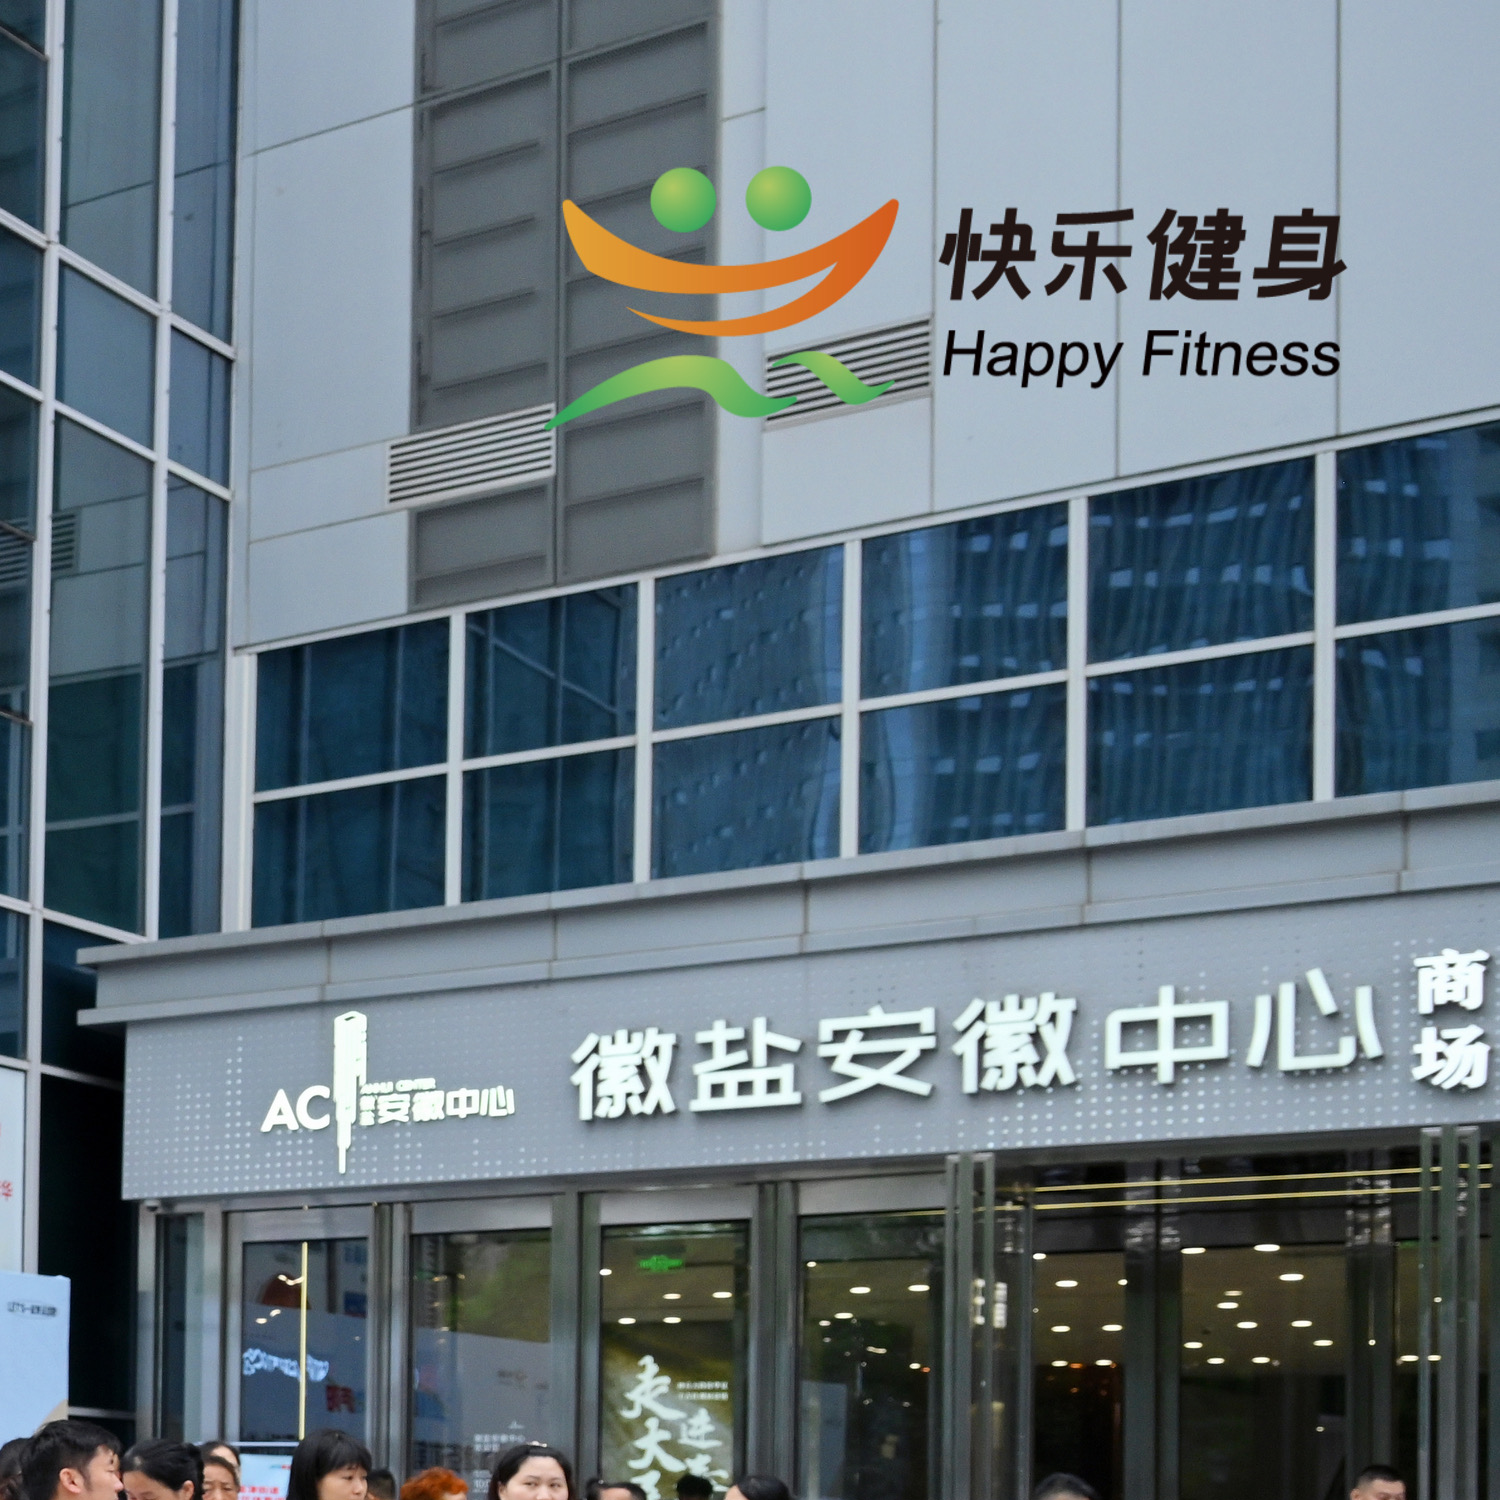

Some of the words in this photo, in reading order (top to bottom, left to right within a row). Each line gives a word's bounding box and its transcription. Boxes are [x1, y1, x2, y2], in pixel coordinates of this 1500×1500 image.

[571, 967, 1384, 1122] 徽盐安徽中心
[1411, 948, 1490, 1091] 商场
[261, 1085, 331, 1132] AC
